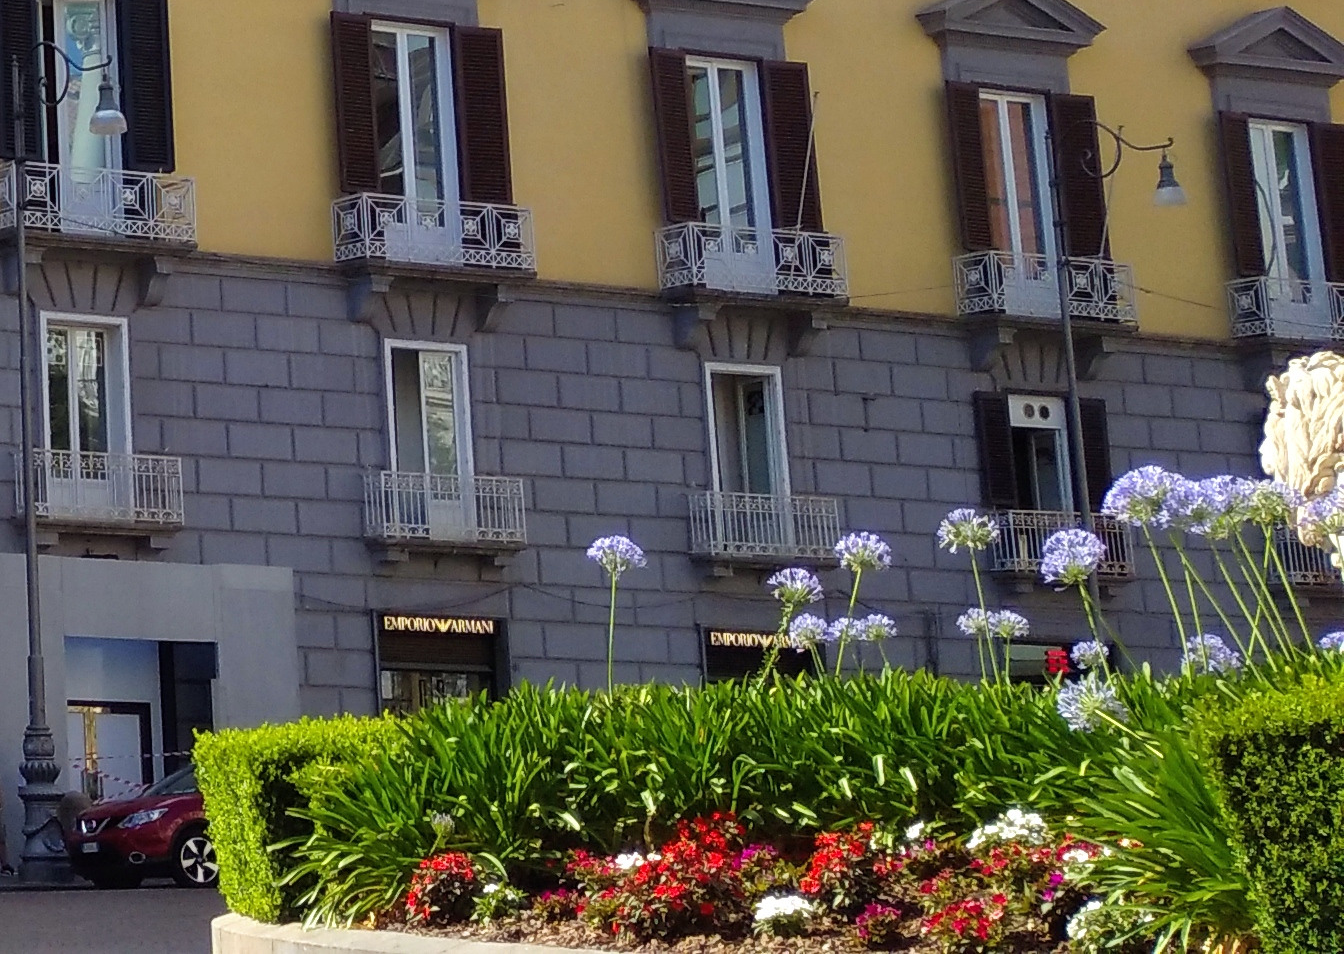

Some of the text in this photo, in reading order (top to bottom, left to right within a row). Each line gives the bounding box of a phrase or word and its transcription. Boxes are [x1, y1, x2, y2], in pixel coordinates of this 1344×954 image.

[383, 615, 494, 634] EMPORIO ARMANI
[710, 631, 759, 647] EMPORIO
